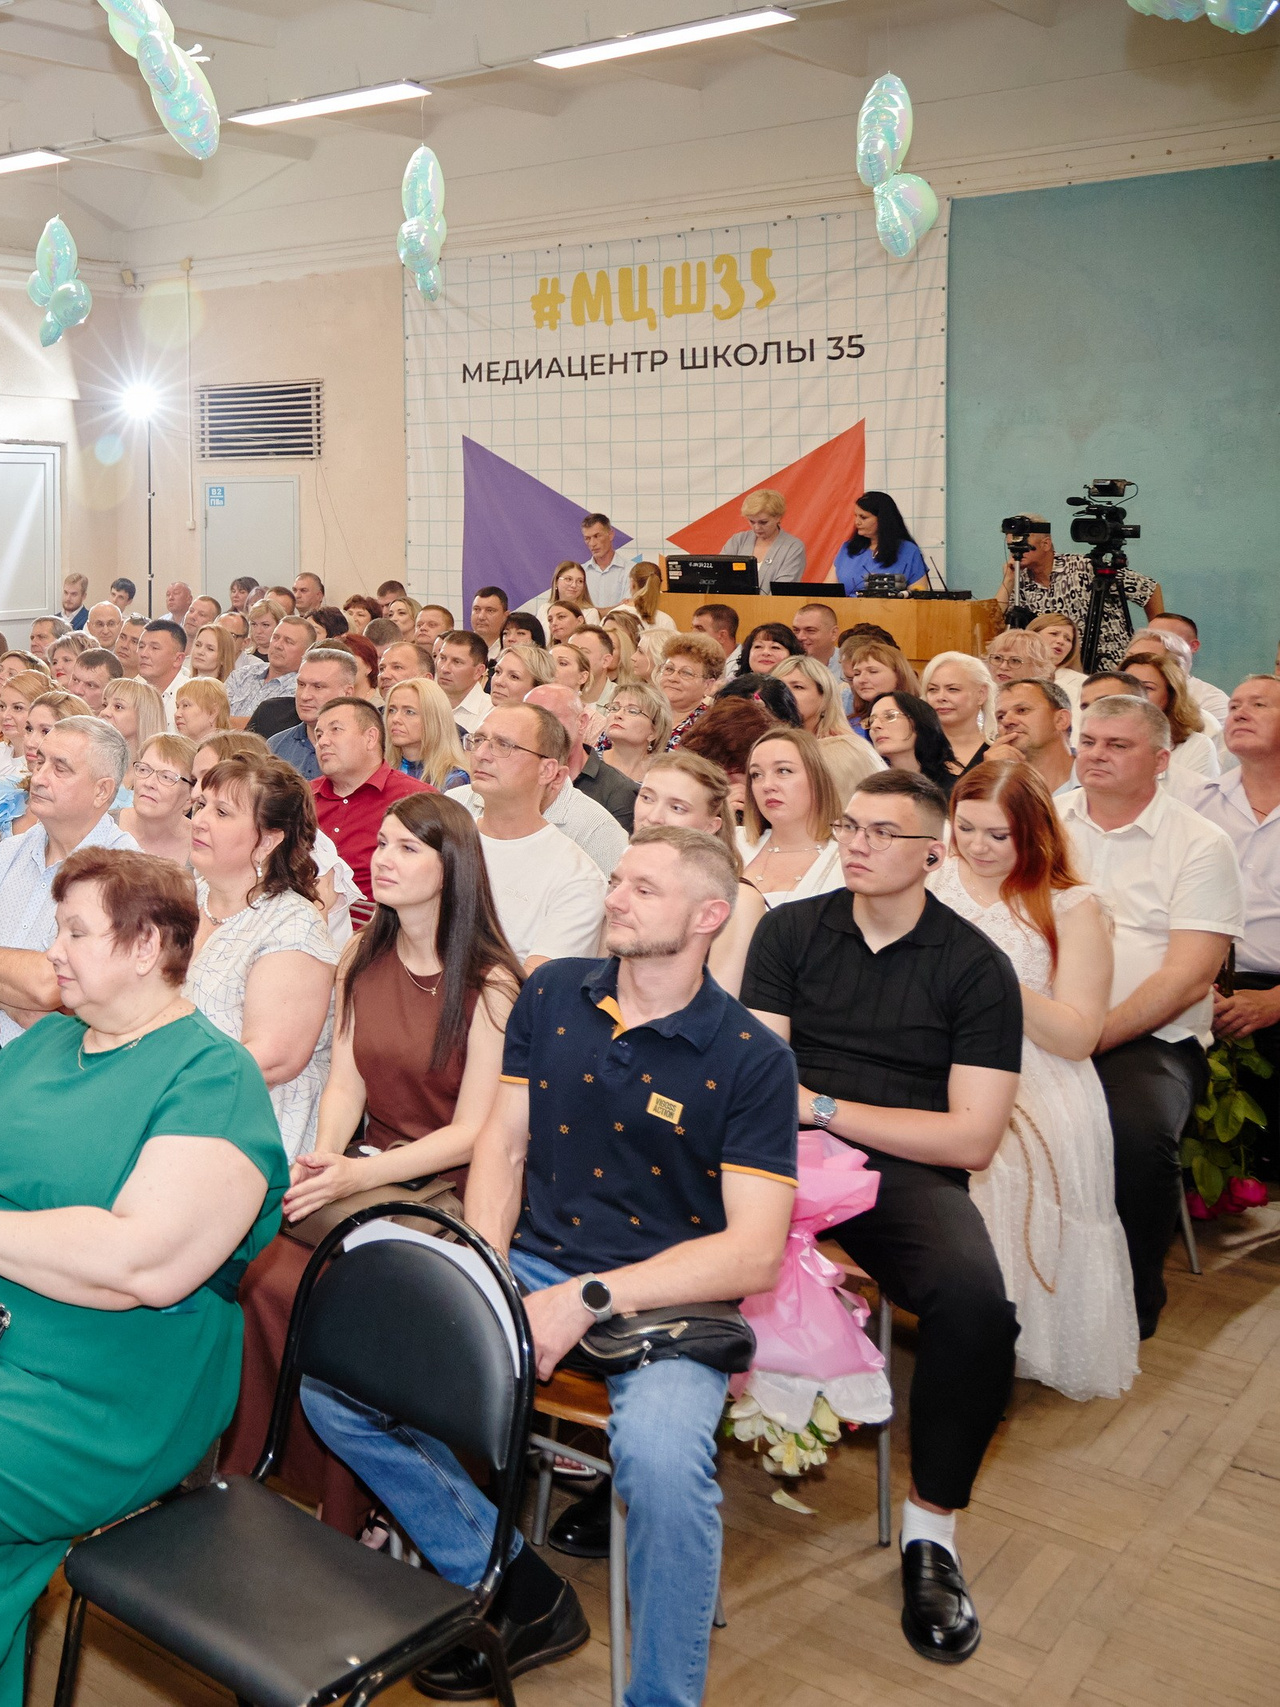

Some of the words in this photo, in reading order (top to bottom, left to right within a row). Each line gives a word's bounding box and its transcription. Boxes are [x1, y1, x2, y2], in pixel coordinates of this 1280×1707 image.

[530, 248, 777, 331] #МЦШ35
[462, 350, 668, 386] МЕДИАЦЕНТР
[680, 339, 815, 370] ШКОЛЫ
[826, 333, 865, 361] 35
[652, 1105, 675, 1119] ACTION
